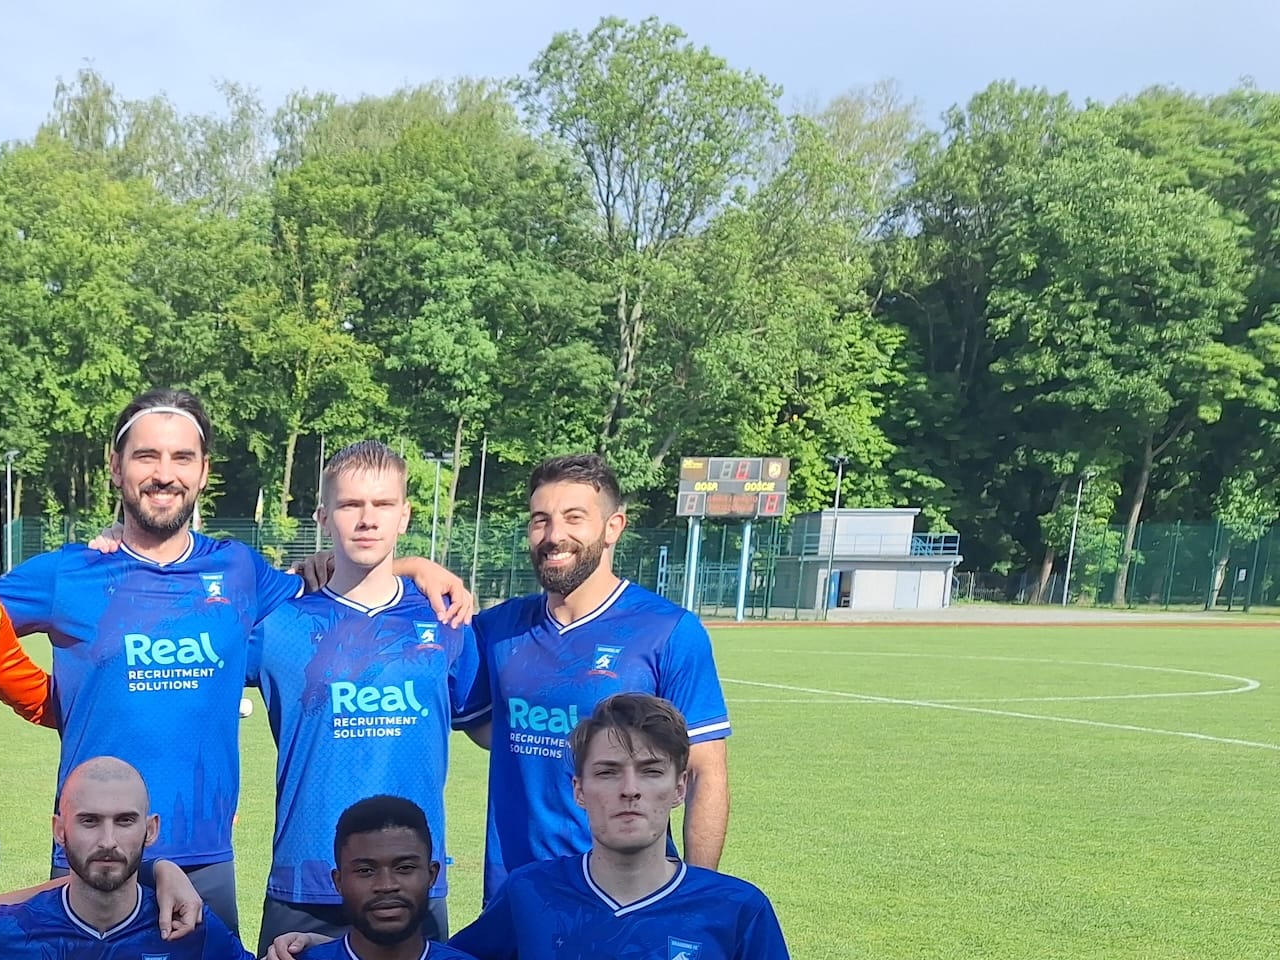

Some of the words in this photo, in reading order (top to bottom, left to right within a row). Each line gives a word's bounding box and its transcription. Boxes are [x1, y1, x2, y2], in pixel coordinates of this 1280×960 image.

[124, 632, 225, 669] Real.
[128, 668, 215, 680] RECRUITMENT
[128, 680, 199, 692] SOLUTIONS
[330, 680, 429, 717] Real.
[334, 716, 418, 728] RECRUITMENT
[508, 698, 579, 735] Real
[333, 728, 402, 739] SOLUTIONS
[510, 733, 572, 749] RECRUITMEN
[510, 744, 563, 759] SOLUTIONS
